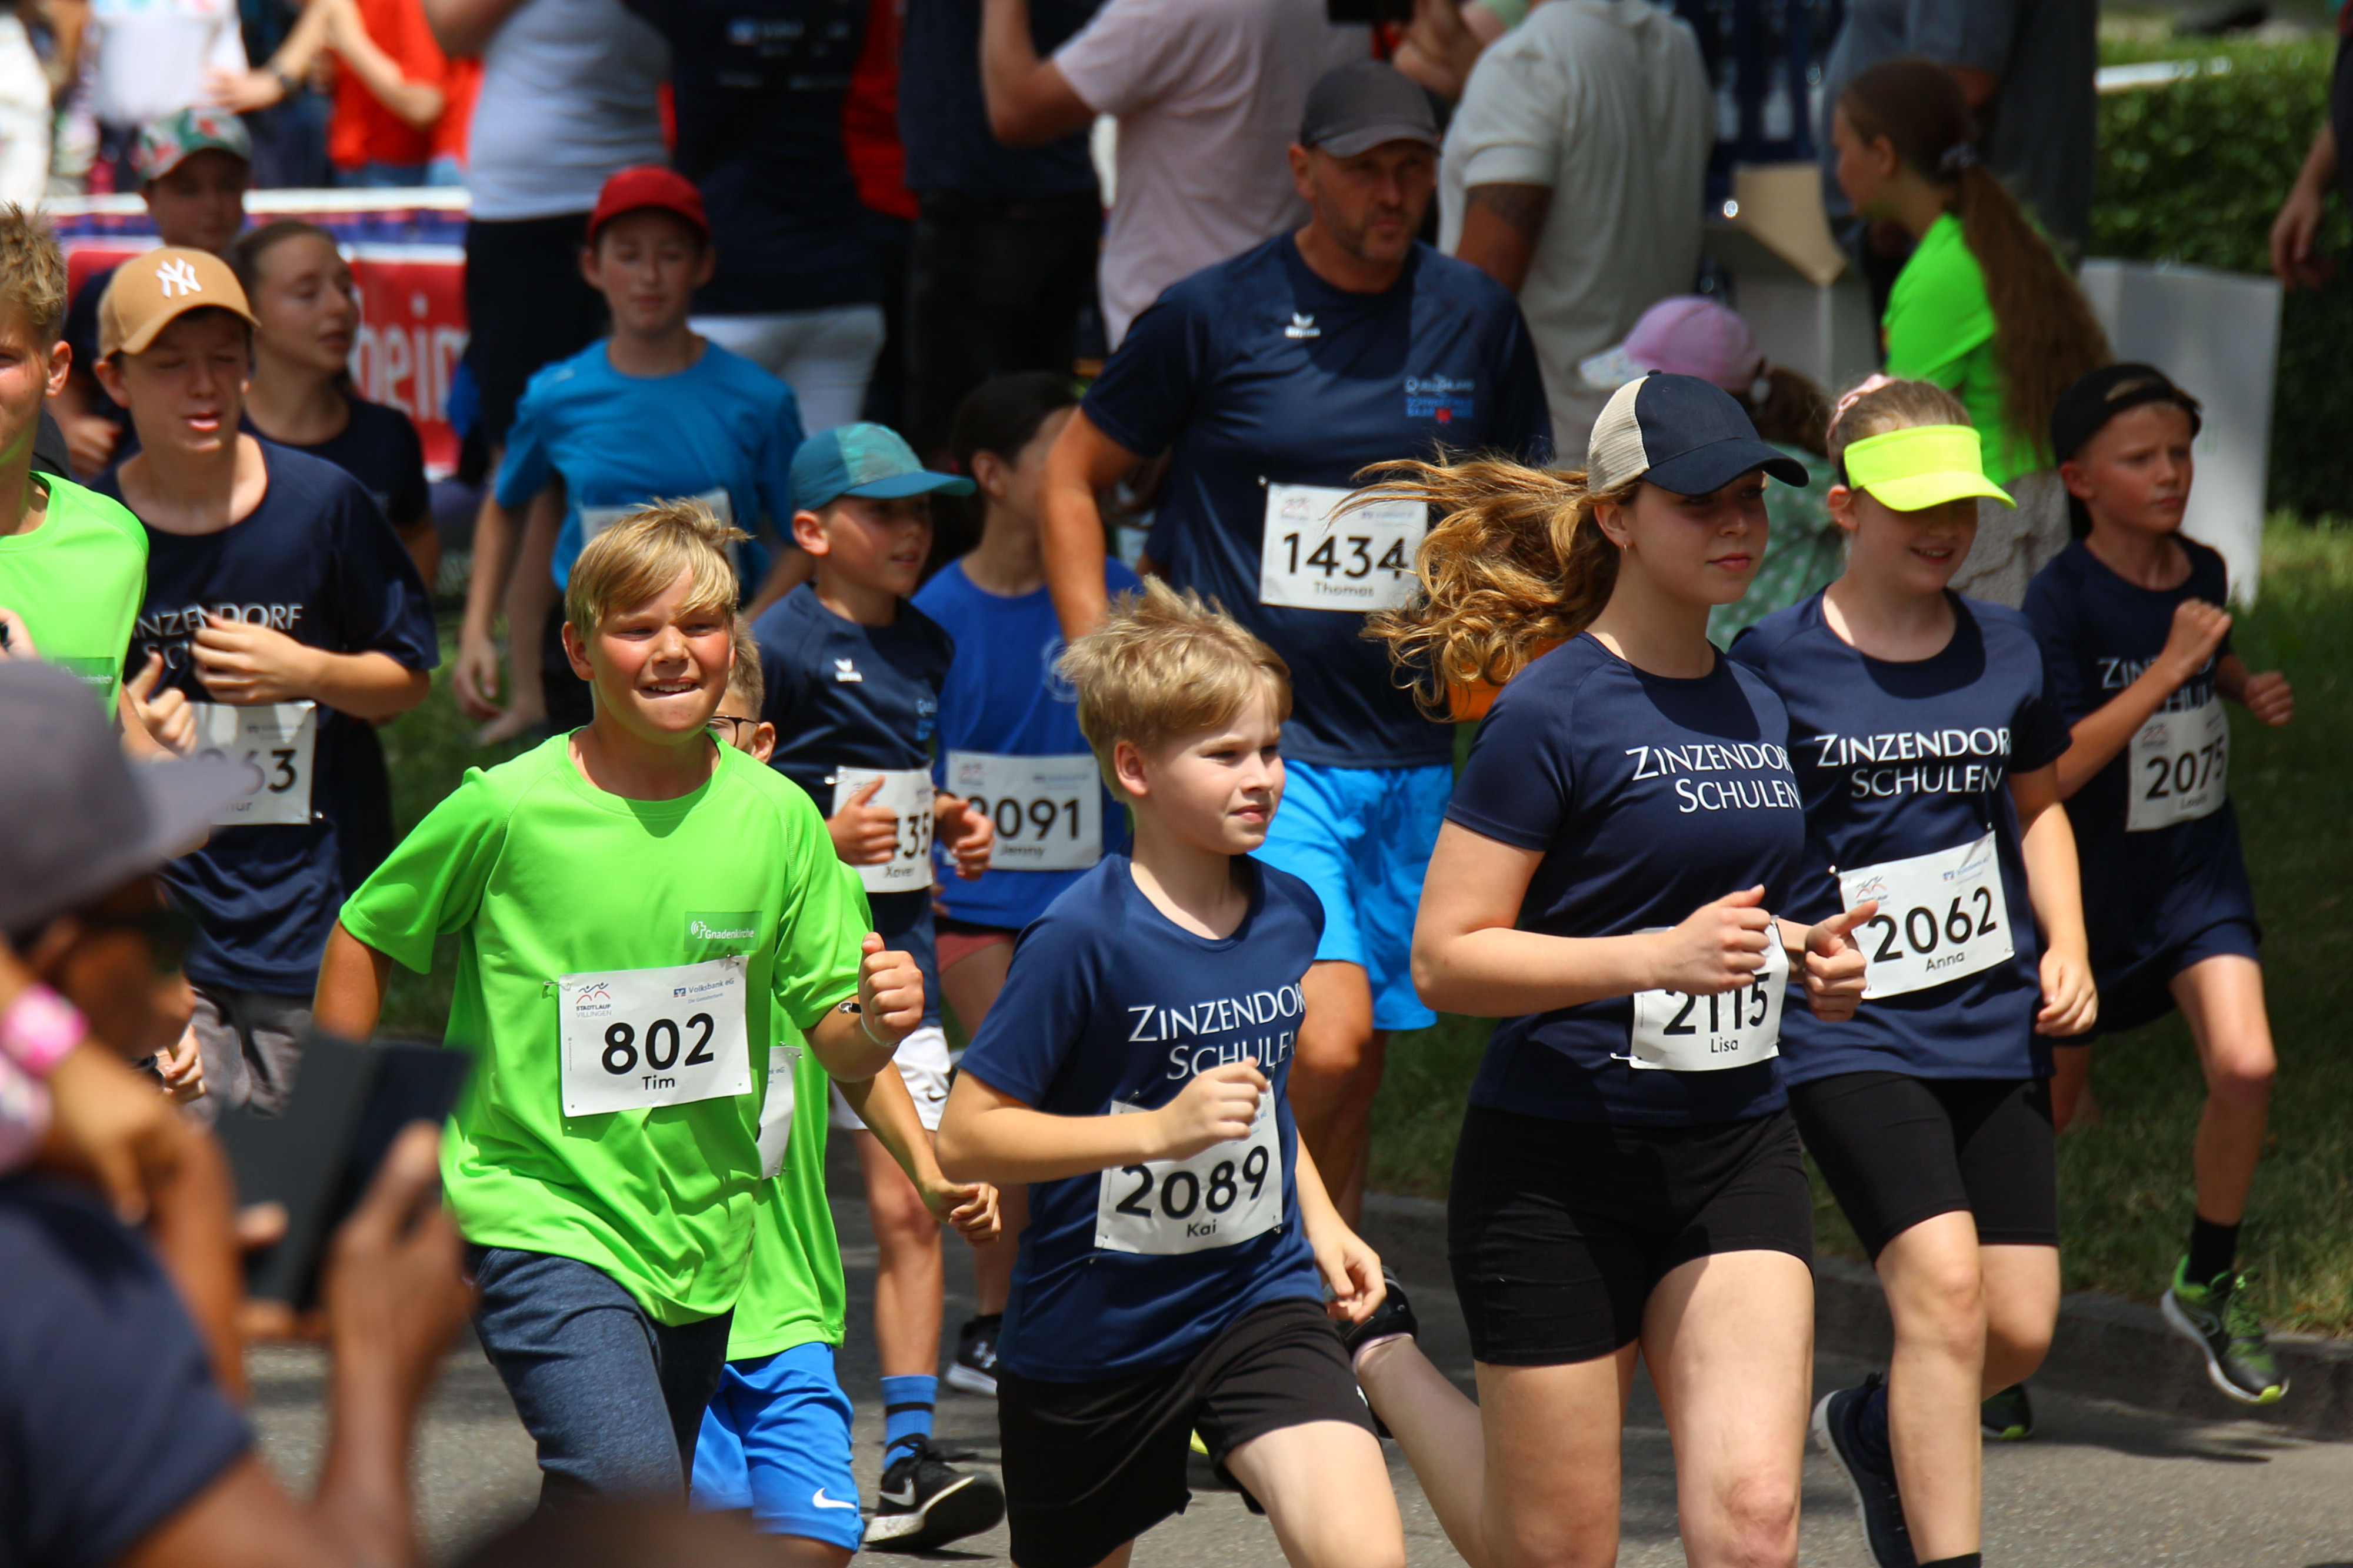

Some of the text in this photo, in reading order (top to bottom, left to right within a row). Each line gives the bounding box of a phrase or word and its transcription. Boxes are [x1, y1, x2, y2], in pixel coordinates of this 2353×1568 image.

[1284, 532, 1409, 579] 1434
[1313, 581, 1374, 597] Thomas
[1625, 743, 1794, 780] ZINZENDOR
[1814, 728, 2011, 767] ZINZENDOR
[1852, 765, 2002, 798] SCHULEN
[2145, 735, 2224, 802] 2075
[1676, 779, 1801, 813] SCHULEN
[885, 866, 914, 878] Xaver
[705, 928, 755, 939] Gnadenkirche
[1867, 886, 1997, 964] 2062
[1925, 952, 1965, 972] Anna
[689, 978, 734, 993] Volksbank eG
[1128, 983, 1307, 1042] ZINZENDOR
[1664, 973, 1771, 1035] 2115
[602, 1013, 714, 1075] 802
[1711, 1037, 1738, 1053] Lisa
[642, 1075, 675, 1090] Tim
[1116, 1145, 1269, 1220] 2089
[1187, 1219, 1217, 1237] Kai
